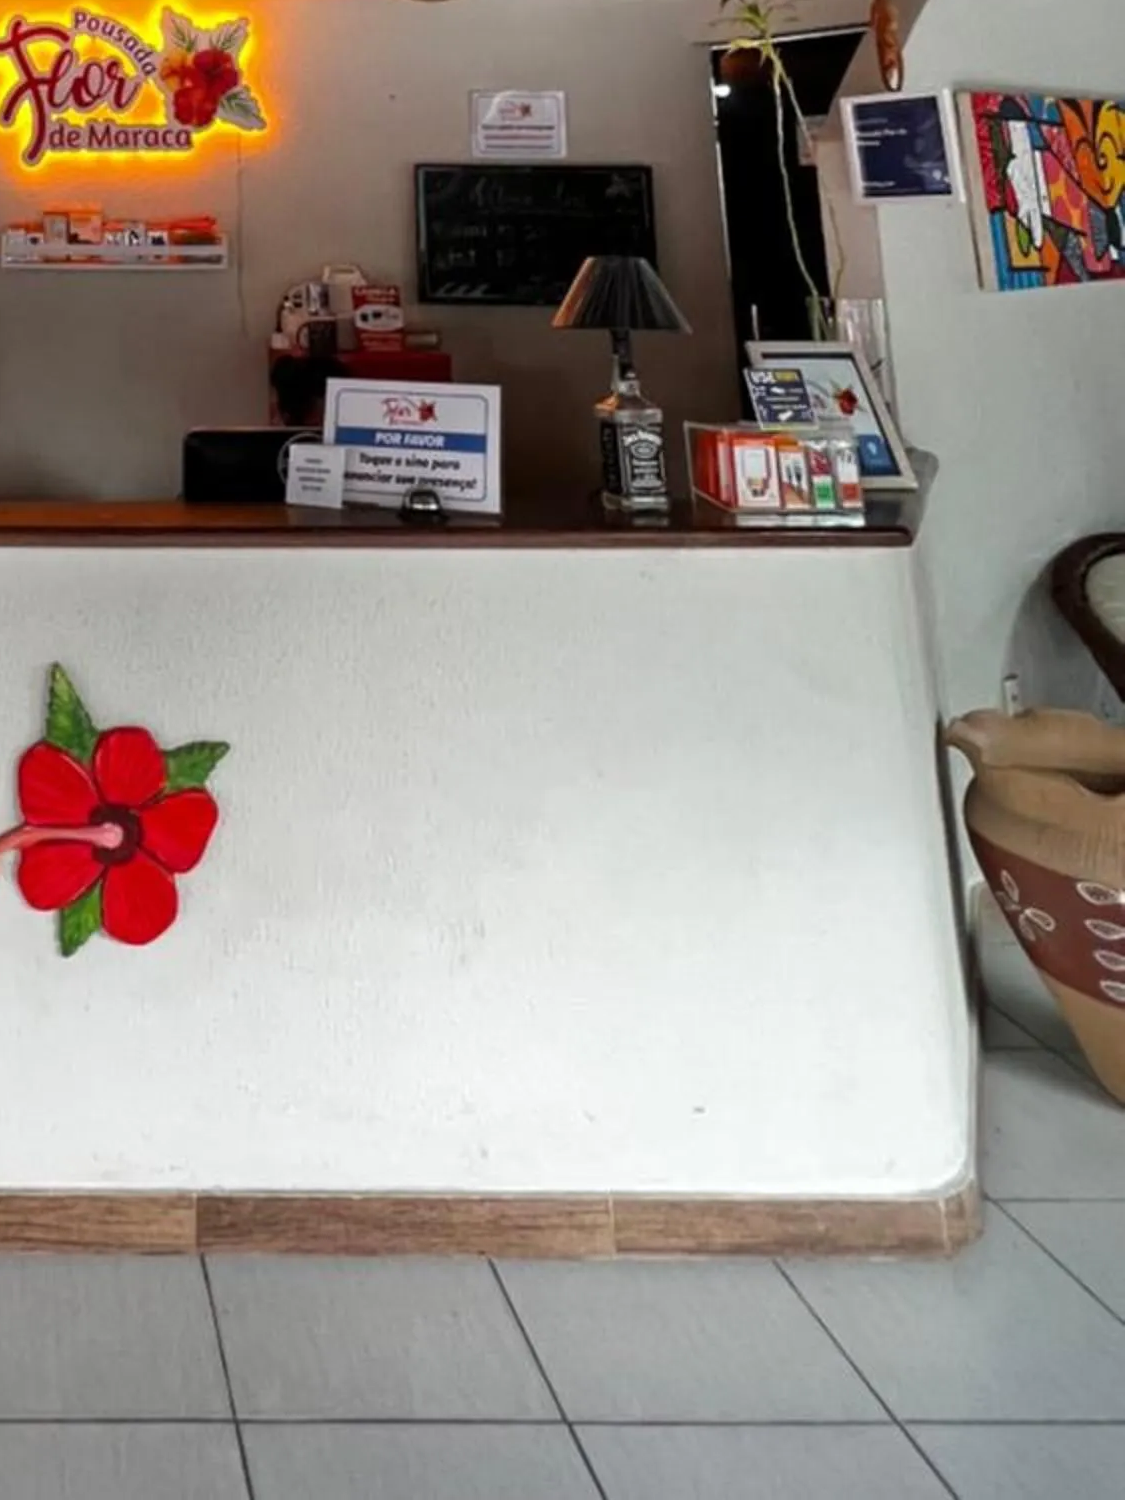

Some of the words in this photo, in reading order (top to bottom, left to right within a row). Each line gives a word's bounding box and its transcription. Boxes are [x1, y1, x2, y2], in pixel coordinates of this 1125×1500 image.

[74, 10, 157, 76] Pousada
[49, 126, 81, 148] de
[87, 125, 192, 149] Maraca
[375, 431, 402, 445] POR
[404, 433, 446, 448] FAVOR
[359, 452, 392, 466] Toque
[405, 454, 430, 468] sino
[431, 458, 460, 470] para
